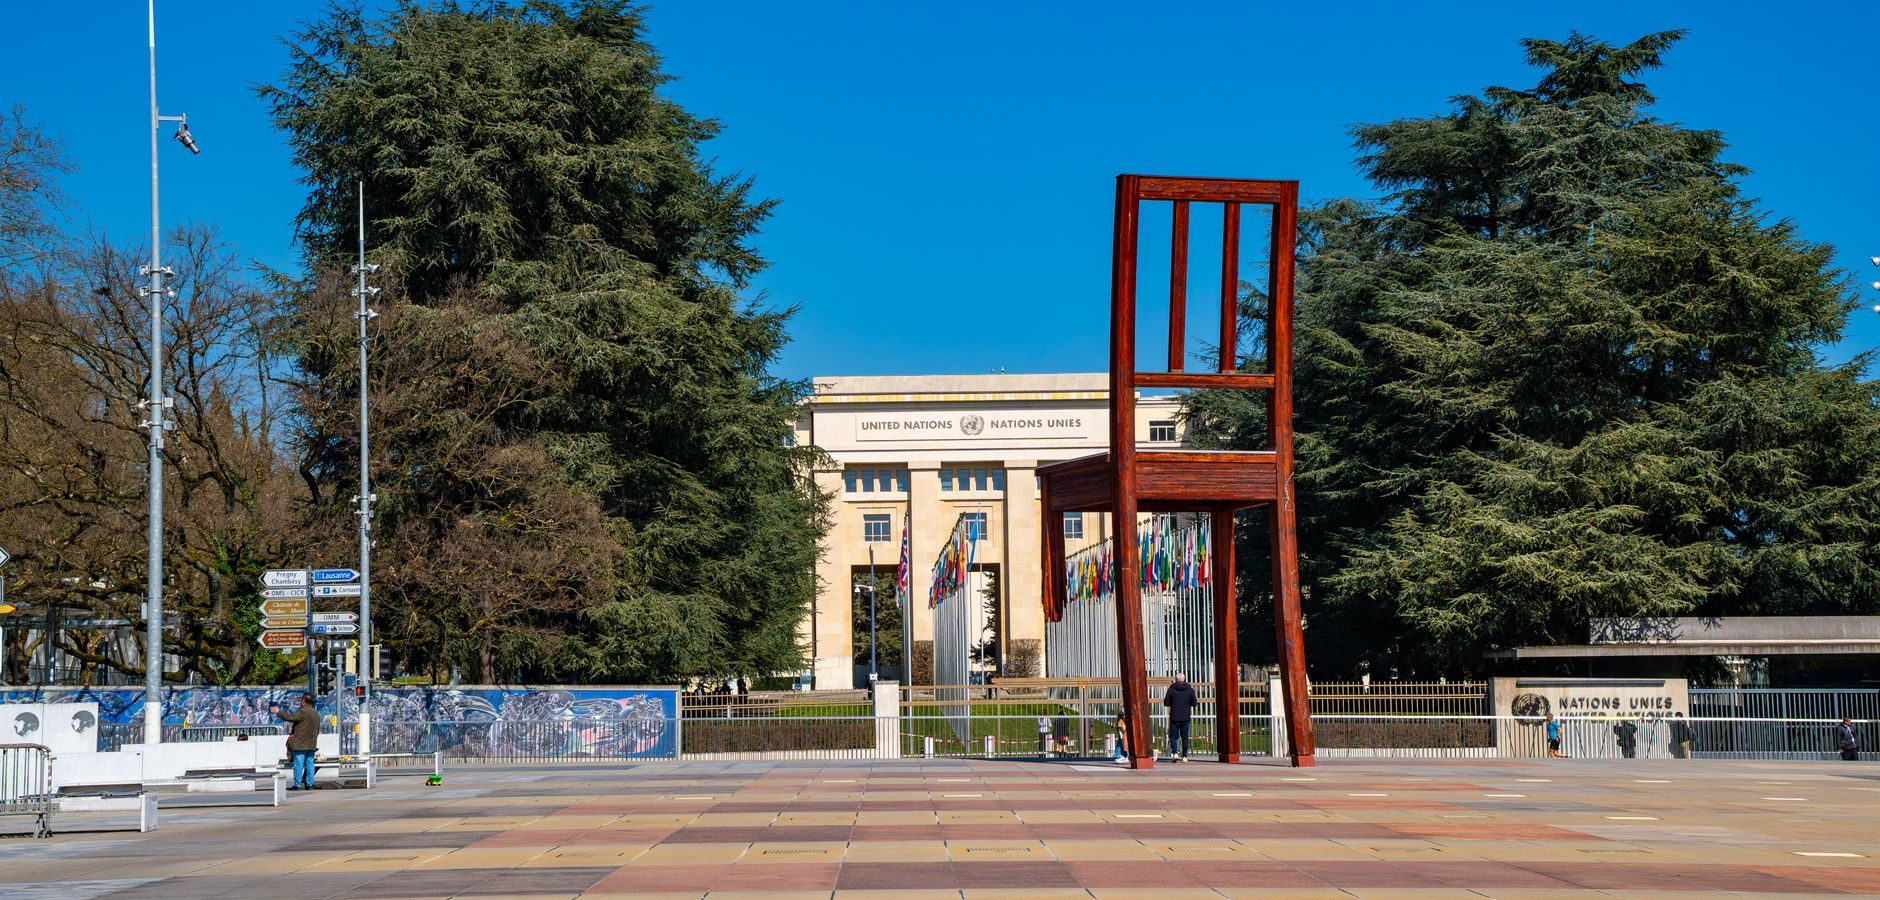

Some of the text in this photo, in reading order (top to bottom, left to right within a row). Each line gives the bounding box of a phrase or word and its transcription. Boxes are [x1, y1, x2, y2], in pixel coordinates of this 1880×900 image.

[861, 418, 1081, 430] UNITED NATIONS NATIONS UNIES
[1559, 697, 1672, 709] NATIONS UNIES
